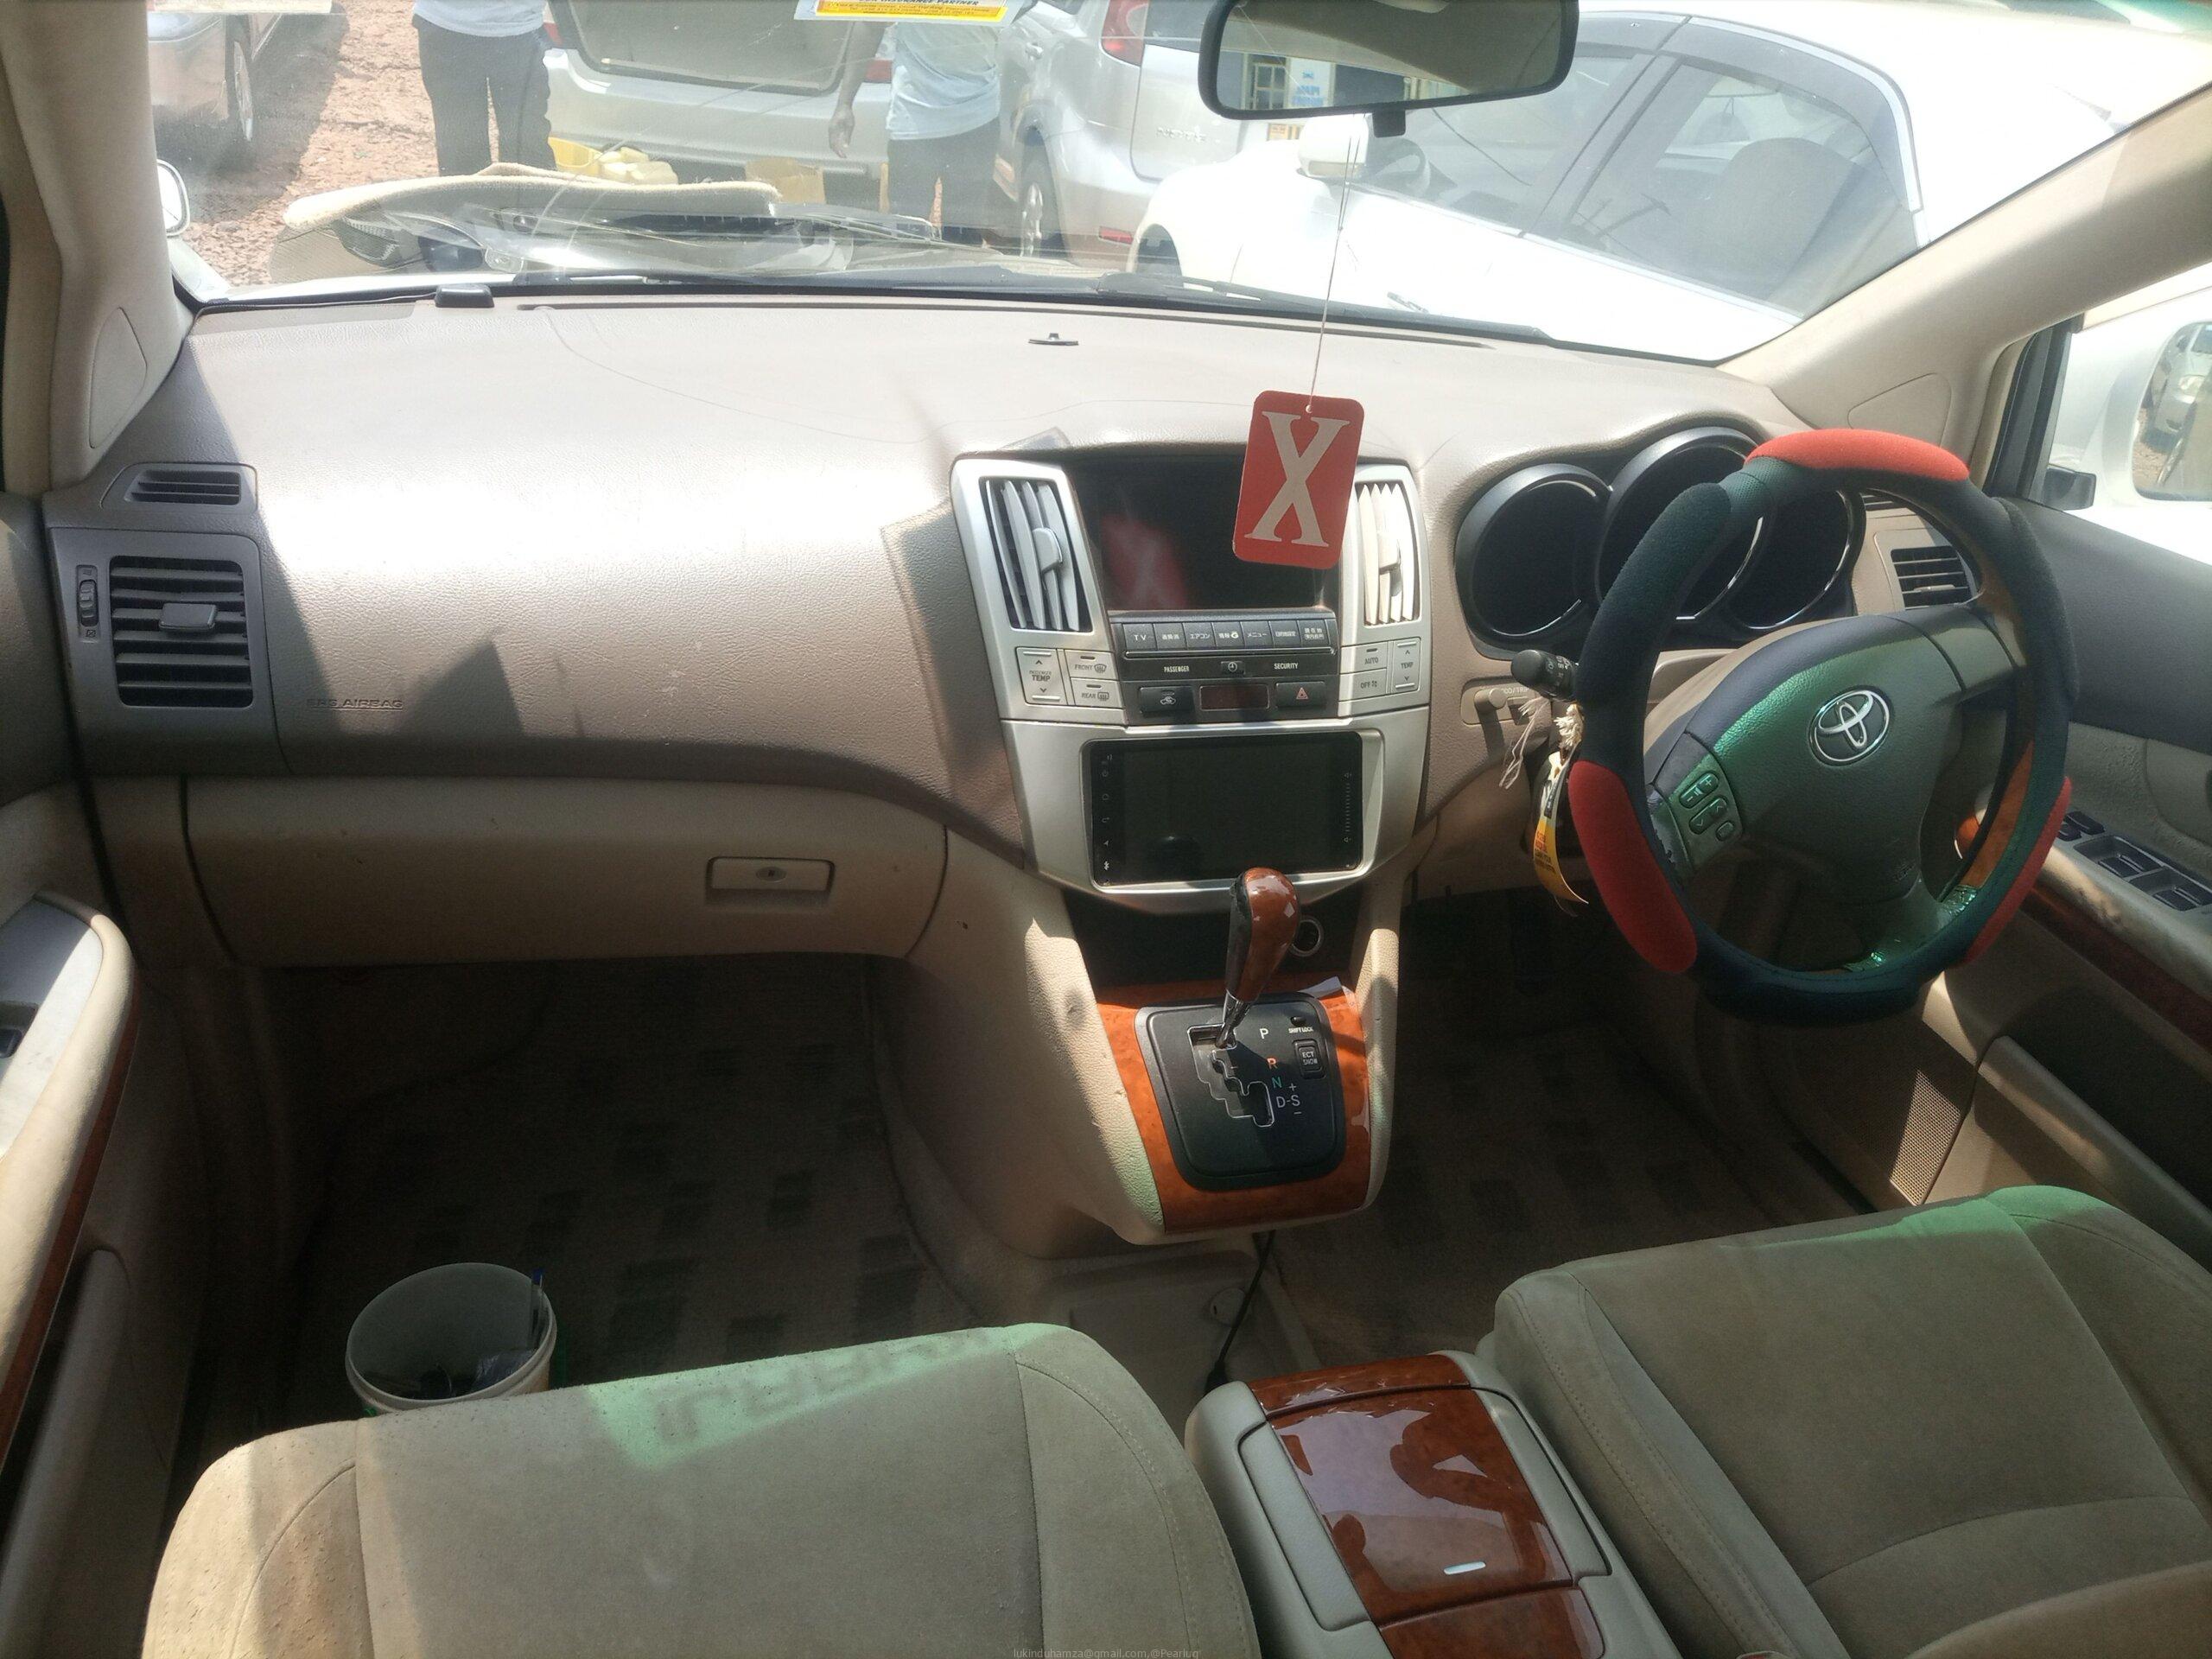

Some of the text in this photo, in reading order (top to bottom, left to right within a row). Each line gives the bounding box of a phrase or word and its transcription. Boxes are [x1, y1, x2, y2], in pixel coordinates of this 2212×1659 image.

[1244, 411, 1351, 547] X
[342, 698, 404, 709] AIRBAG
[1259, 1027, 1269, 1039] P
[1267, 1058, 1278, 1070] R
[1271, 1077, 1282, 1089] N
